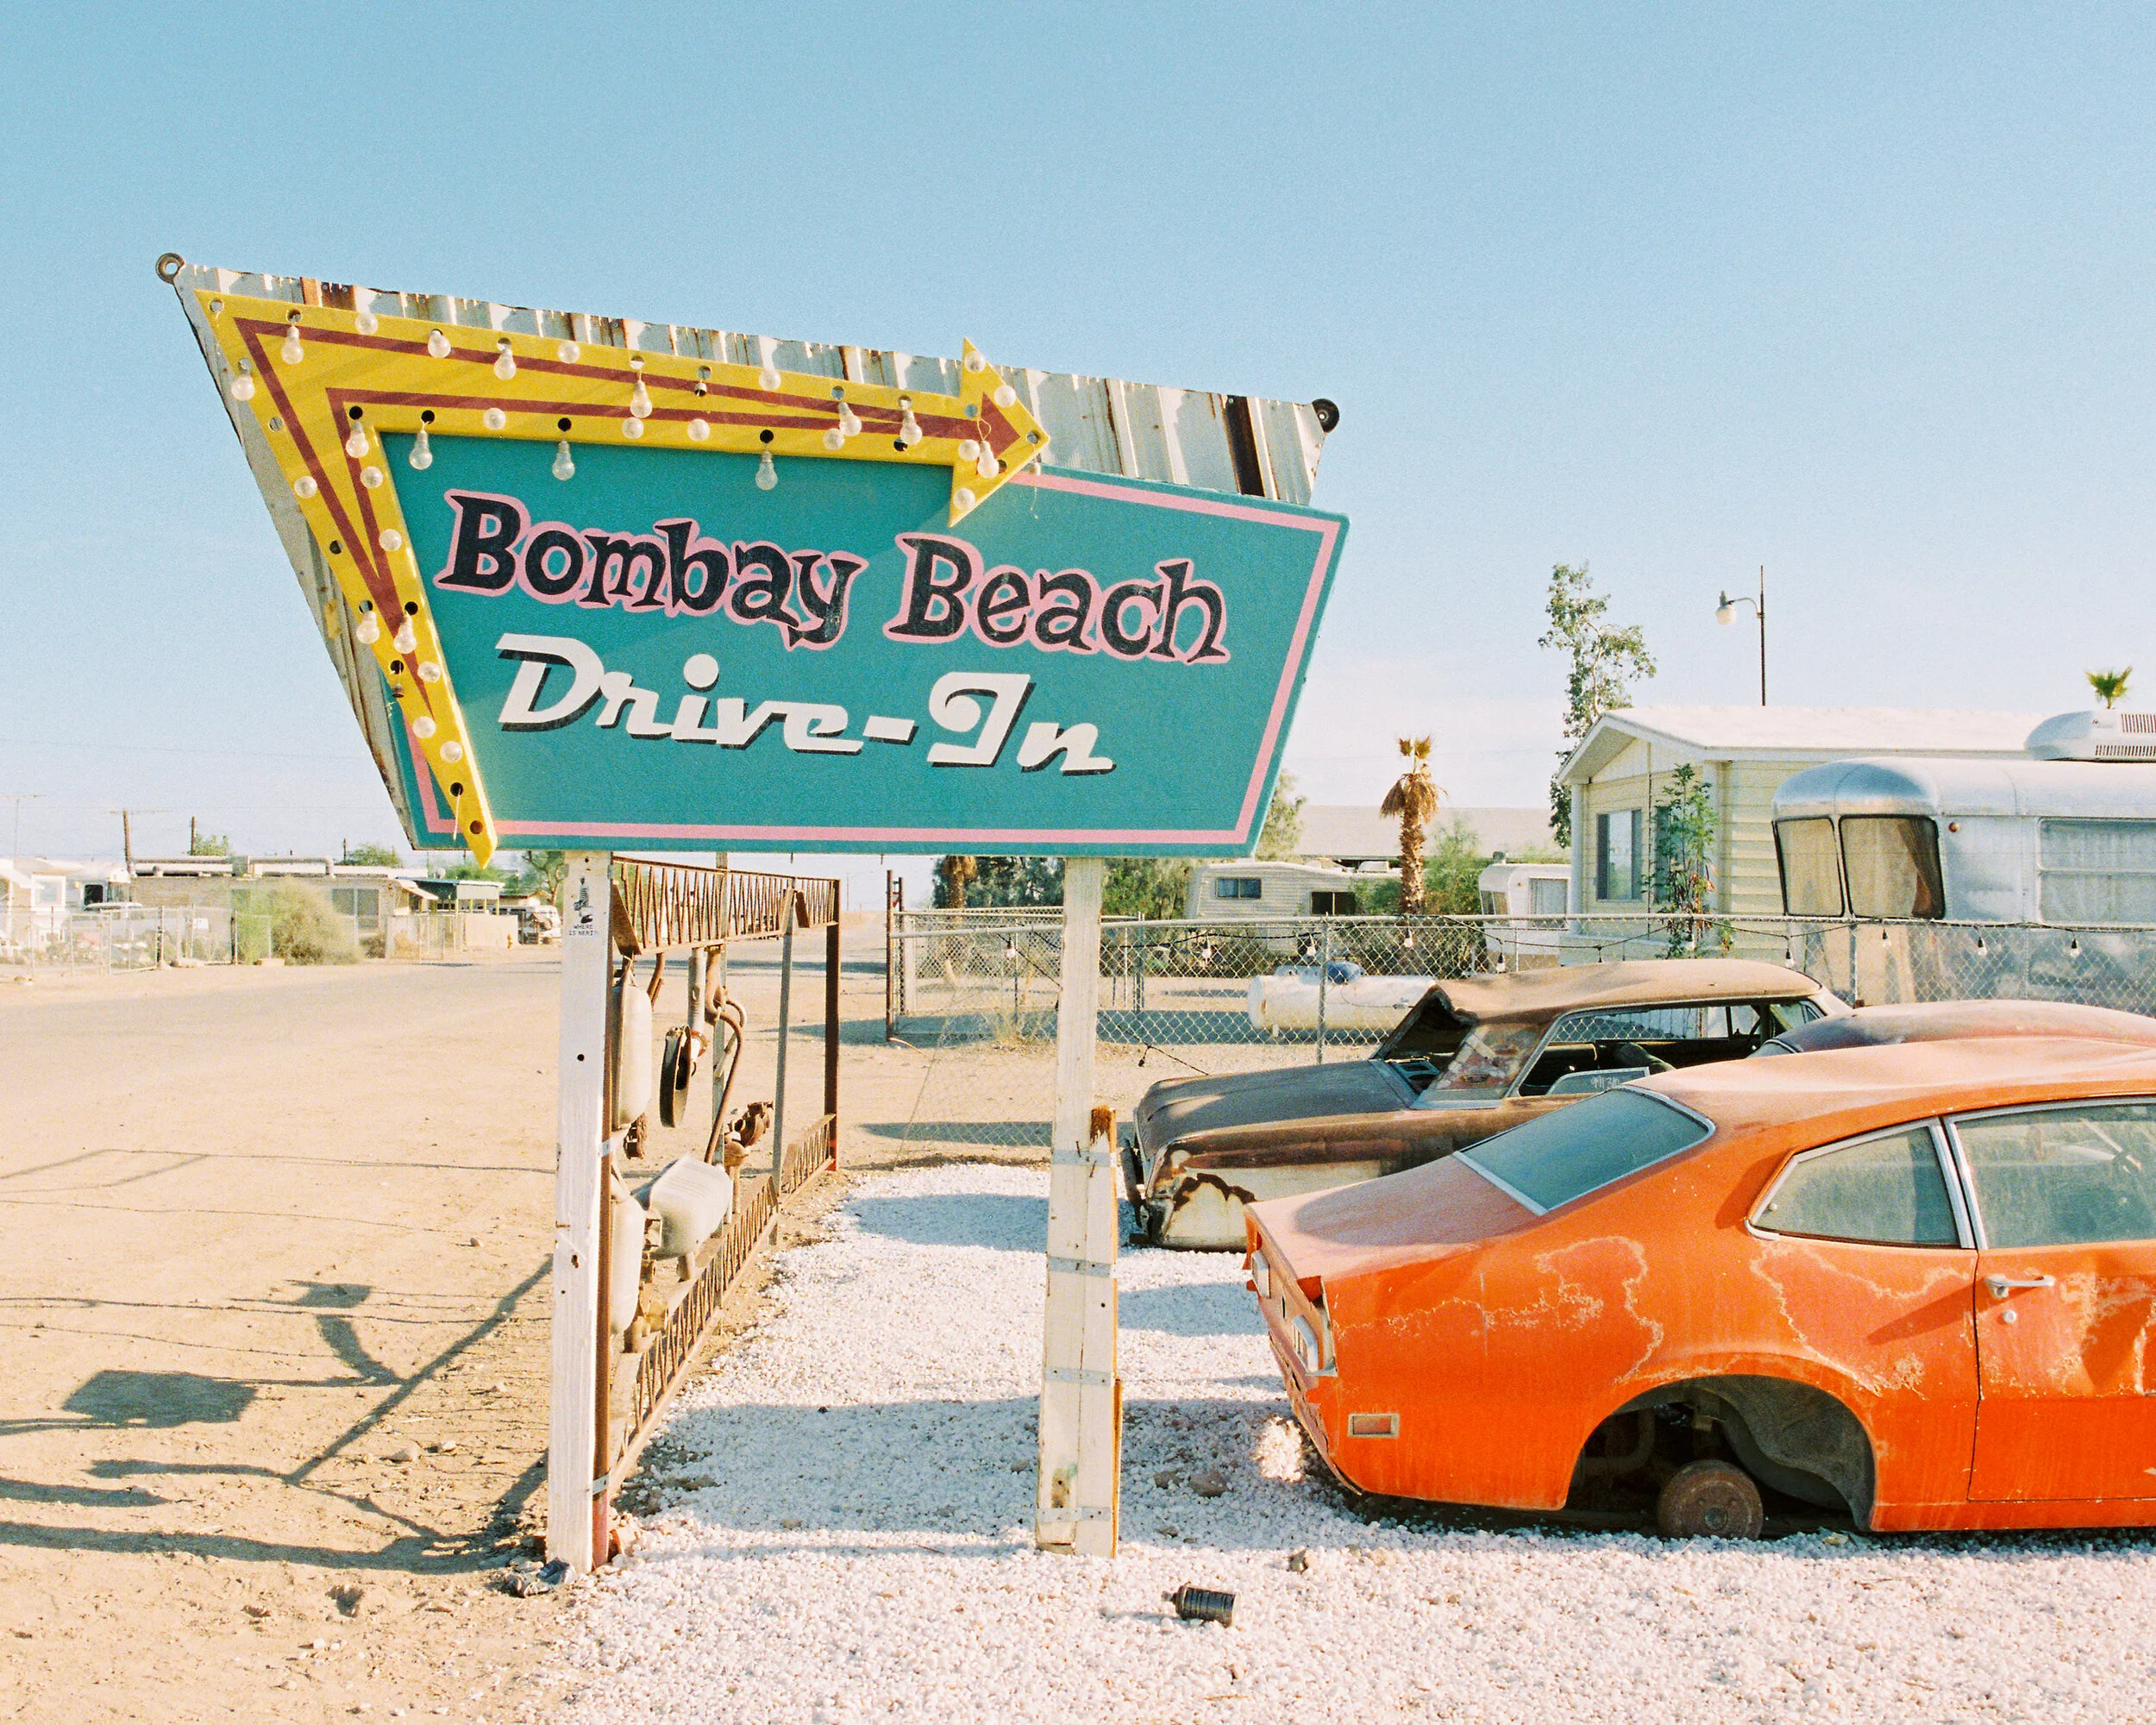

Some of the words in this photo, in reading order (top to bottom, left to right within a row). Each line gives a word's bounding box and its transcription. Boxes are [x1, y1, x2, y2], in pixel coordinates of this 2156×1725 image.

[435, 491, 869, 651] Bombay
[883, 532, 1231, 663] Beach
[495, 633, 1117, 775] Drive-In
